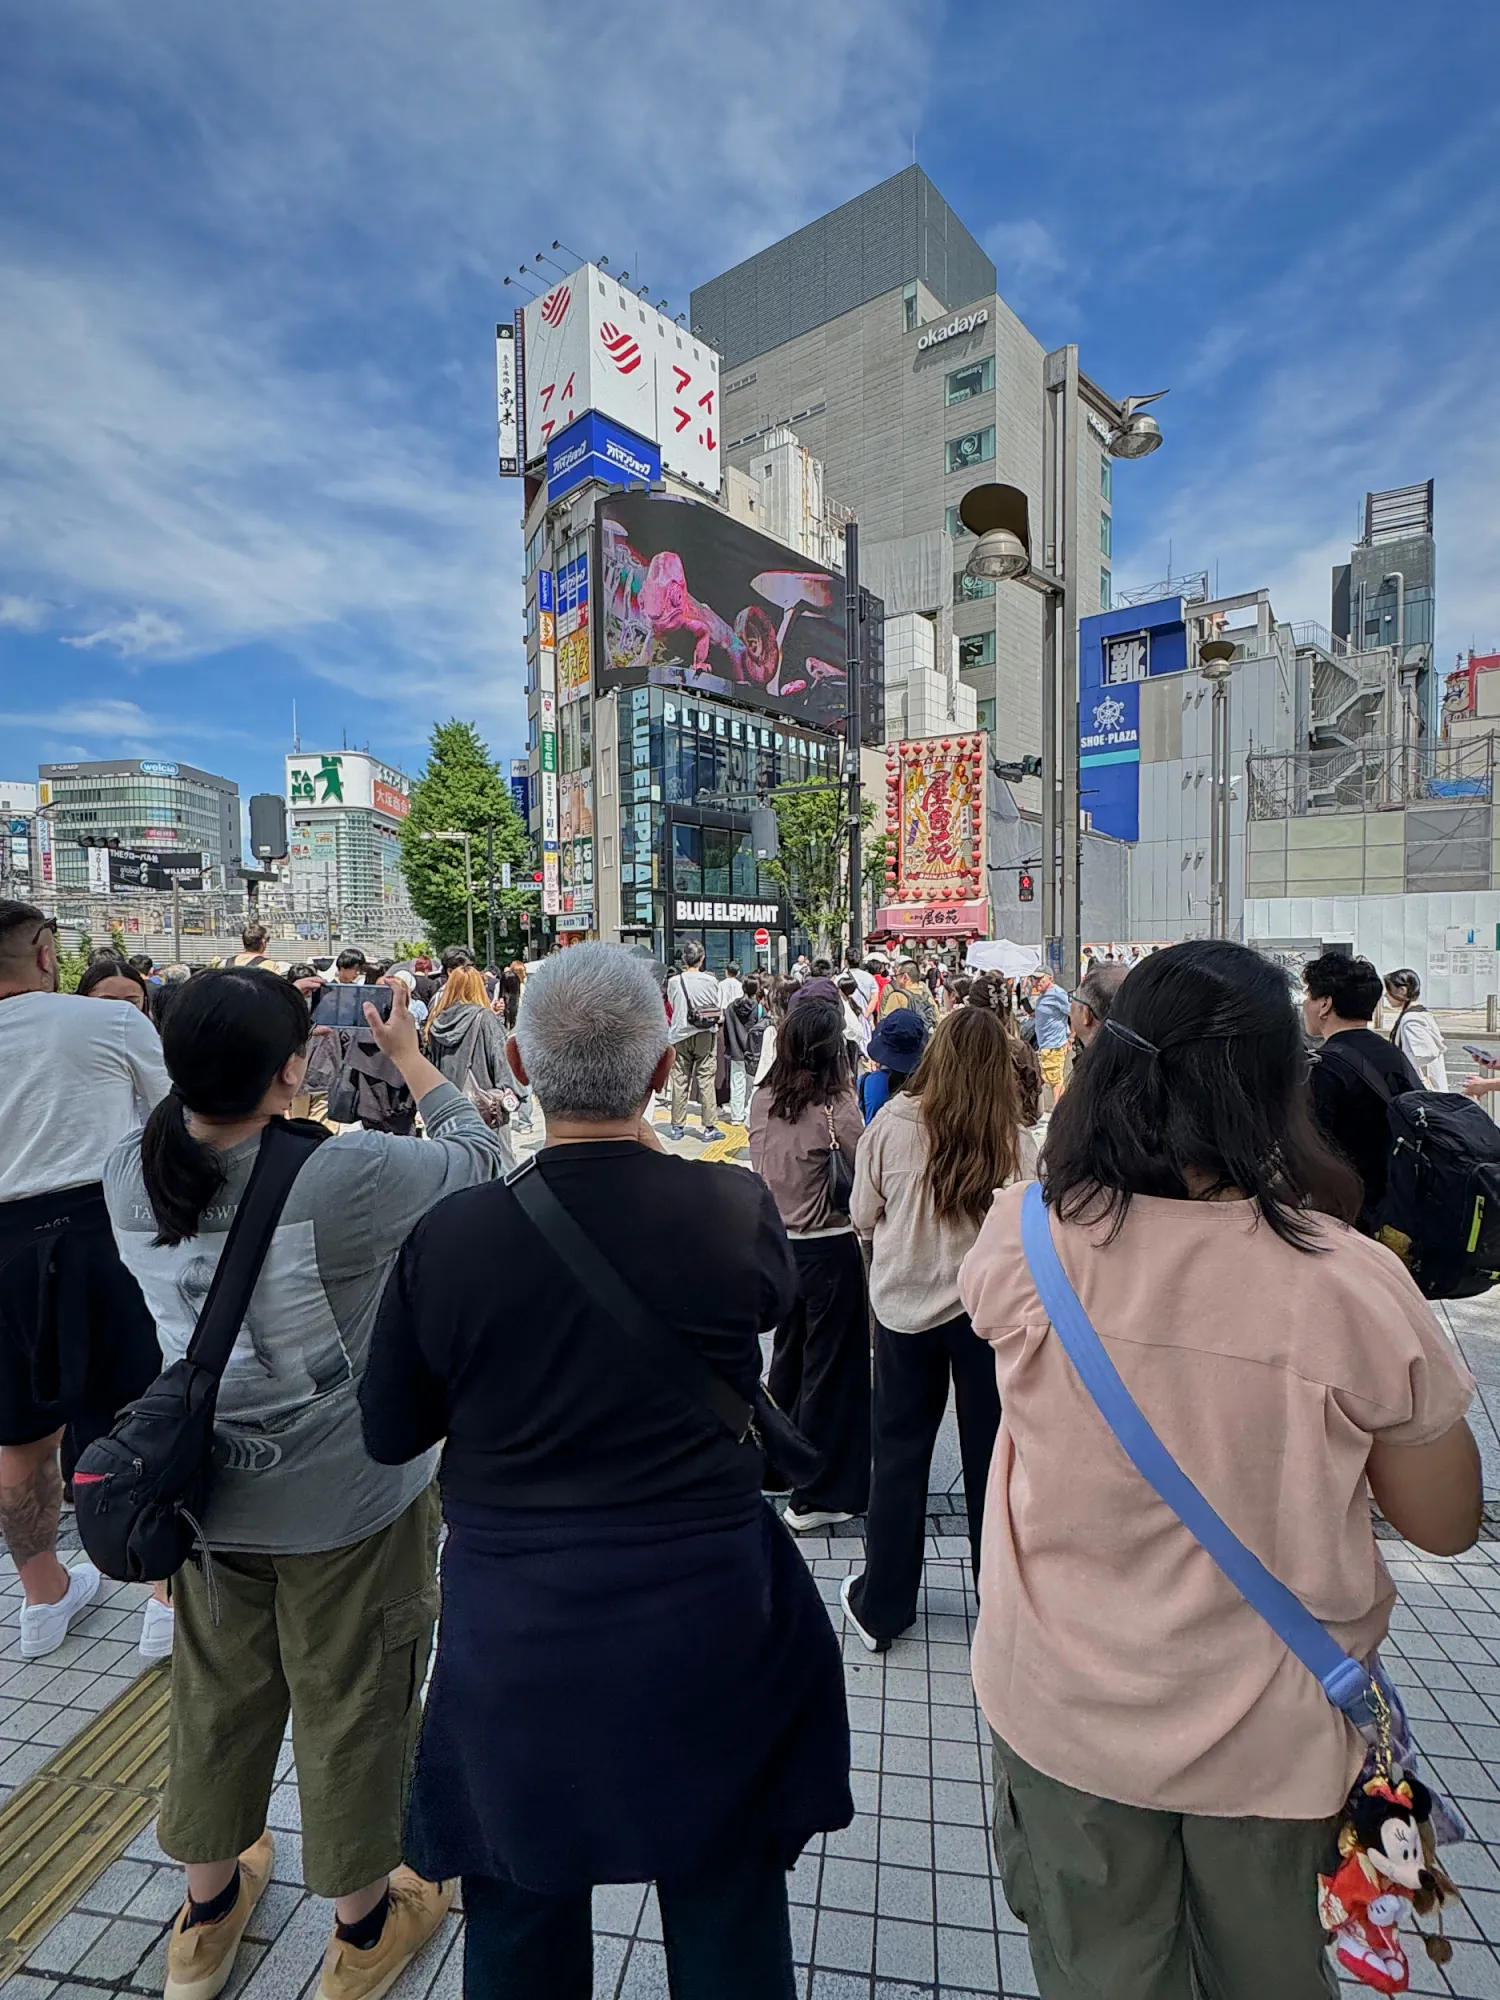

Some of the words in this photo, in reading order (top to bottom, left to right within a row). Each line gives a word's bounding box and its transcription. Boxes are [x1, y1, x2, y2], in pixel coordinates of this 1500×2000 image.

[917, 309, 988, 350] okadaya
[1110, 640, 1146, 684] 靴
[143, 762, 175, 774] welcia
[921, 770, 958, 865] 屋台苑
